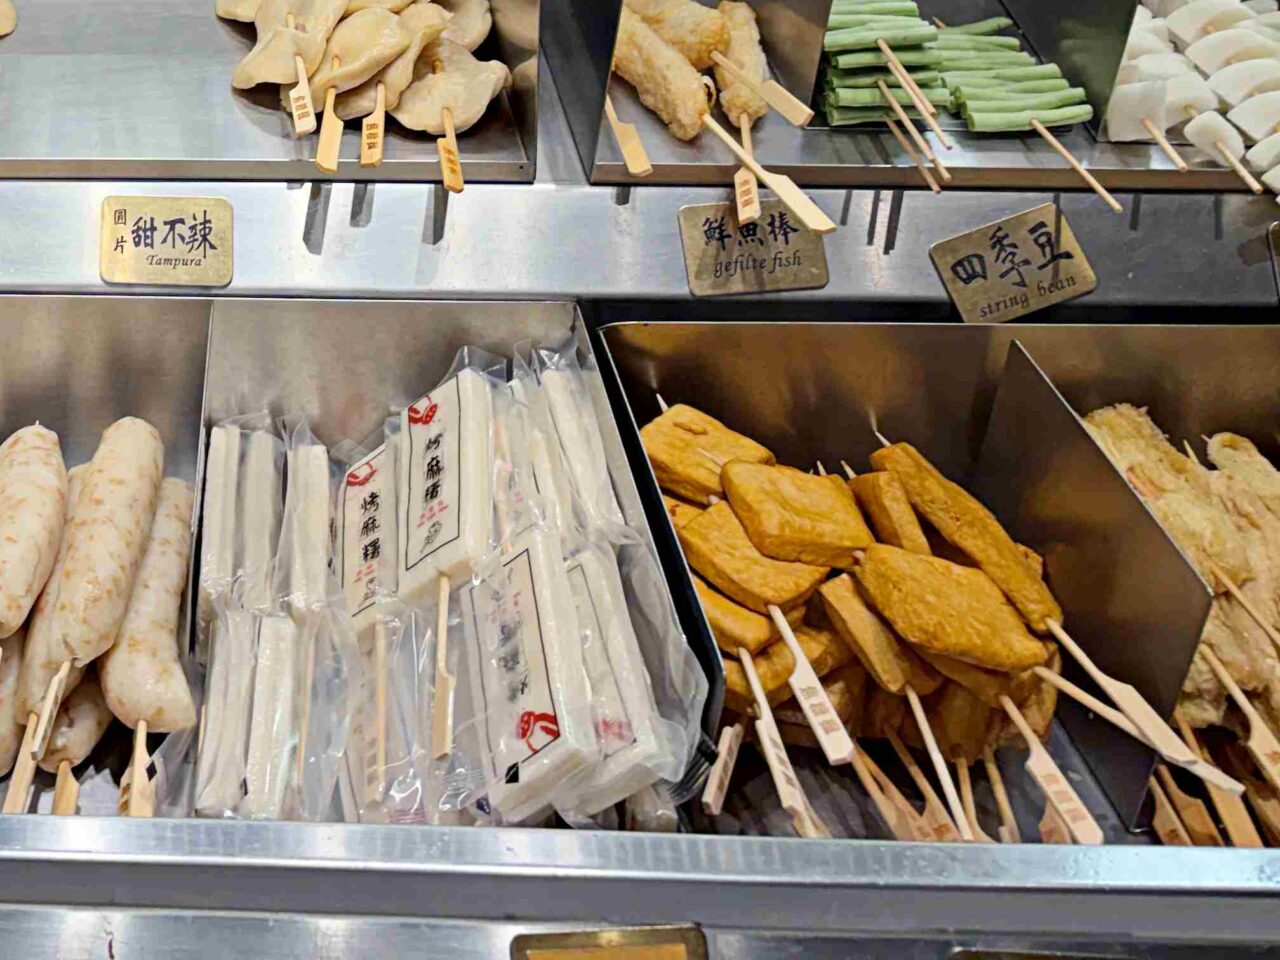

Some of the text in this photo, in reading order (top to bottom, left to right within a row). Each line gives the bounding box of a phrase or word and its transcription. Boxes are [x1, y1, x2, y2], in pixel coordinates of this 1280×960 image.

[131, 209, 218, 259] 甜不辣
[701, 211, 800, 251] 鮮魚棒
[146, 254, 203, 270] Tampura
[713, 249, 803, 279] gefilte fish
[950, 220, 1074, 288] 四季豆
[980, 275, 1078, 318] string bean
